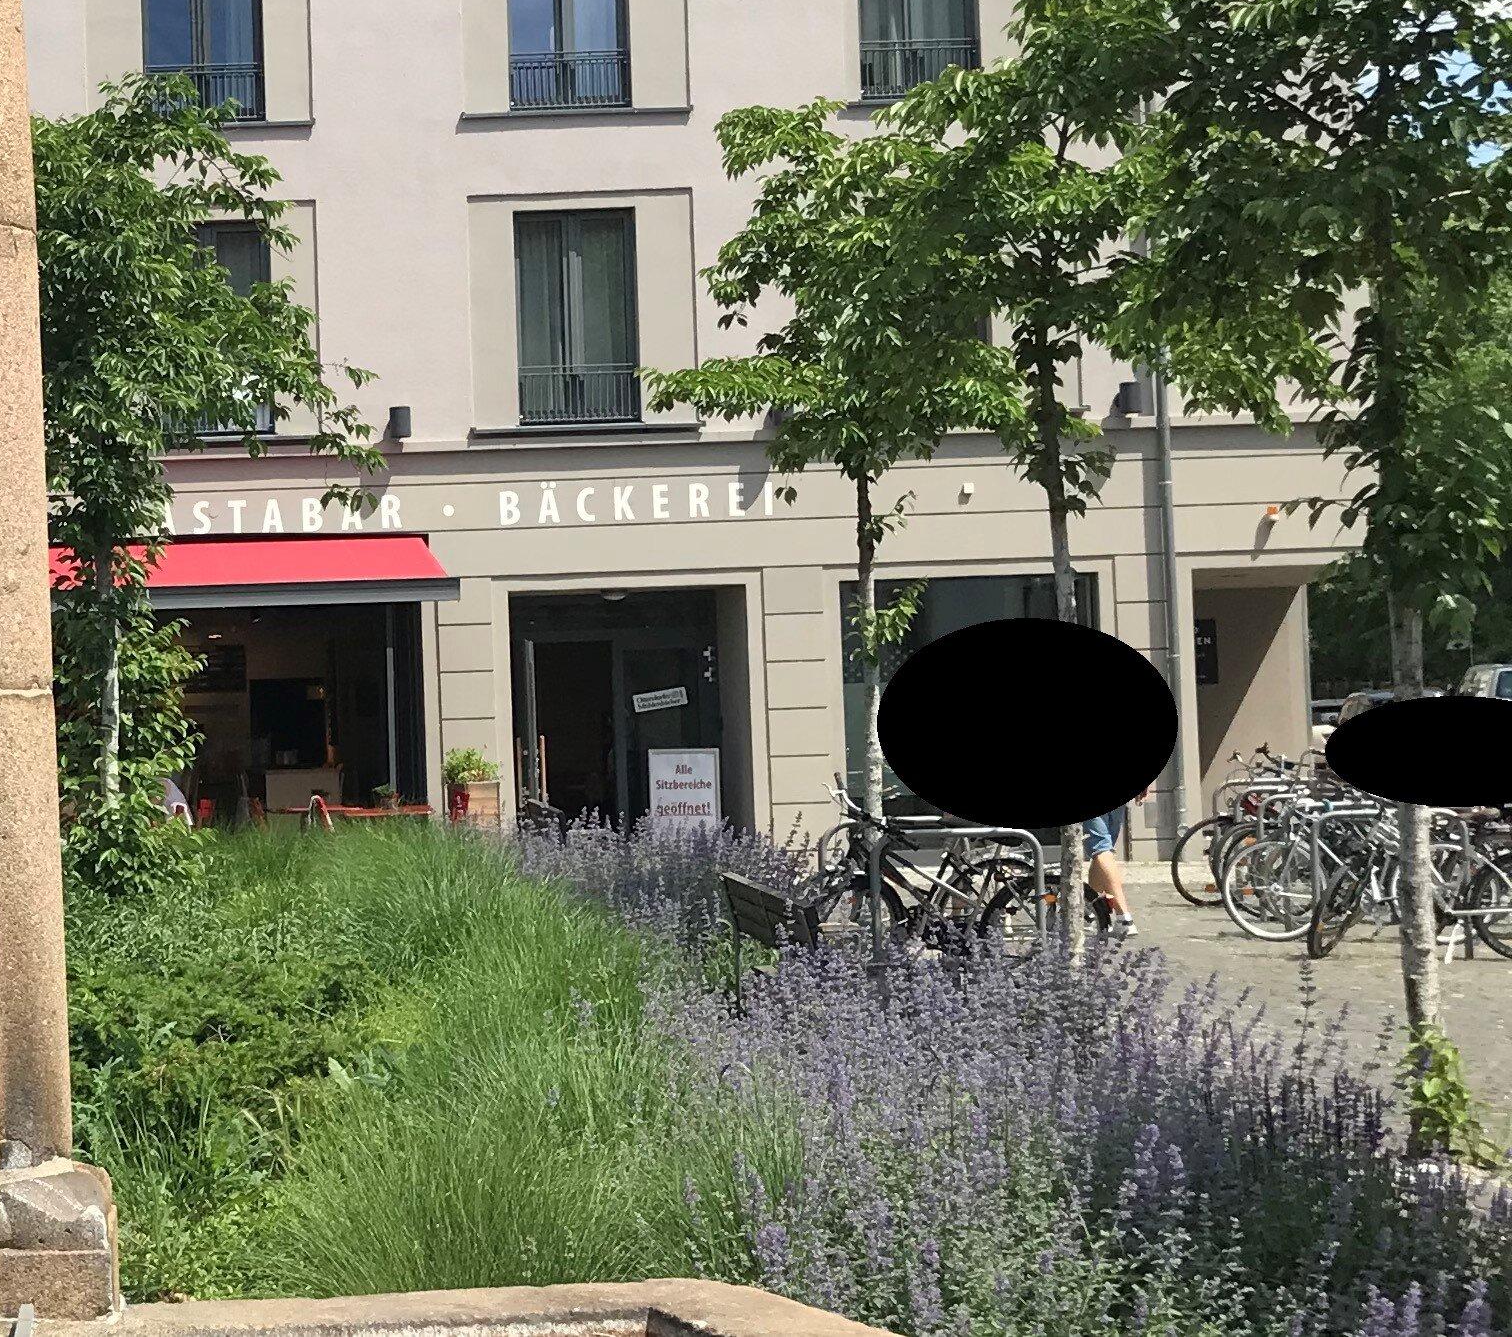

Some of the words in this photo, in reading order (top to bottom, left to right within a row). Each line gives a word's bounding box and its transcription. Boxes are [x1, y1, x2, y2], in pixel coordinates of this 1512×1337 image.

[148, 494, 403, 535] ASTABAR
[499, 481, 774, 526] BÄCKEREI
[675, 764, 693, 775] Alle
[655, 779, 713, 790] Sitzbereiche
[656, 801, 711, 817] geöffnet!
